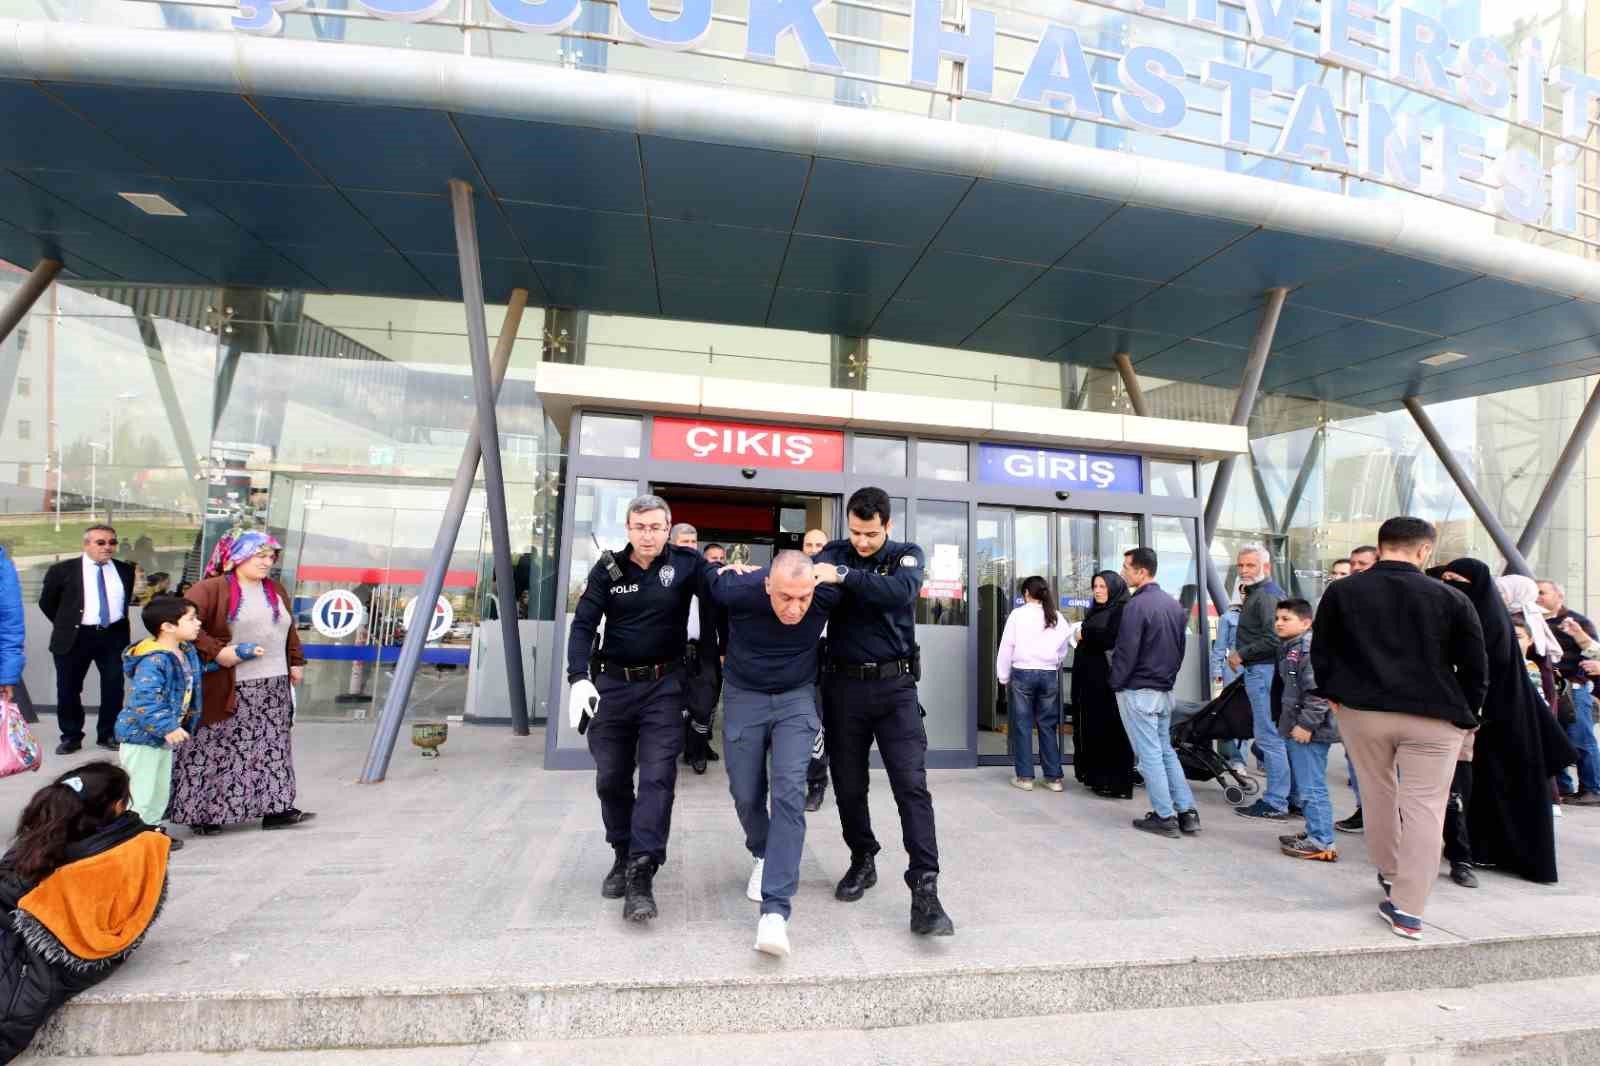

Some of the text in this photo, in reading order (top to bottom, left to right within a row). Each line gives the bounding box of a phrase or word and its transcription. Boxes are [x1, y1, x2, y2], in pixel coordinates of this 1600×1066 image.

[908, 0, 1578, 234] HASTANESİ
[686, 426, 814, 465] ÇIKIŞ
[1003, 451, 1116, 488] GİRİŞ
